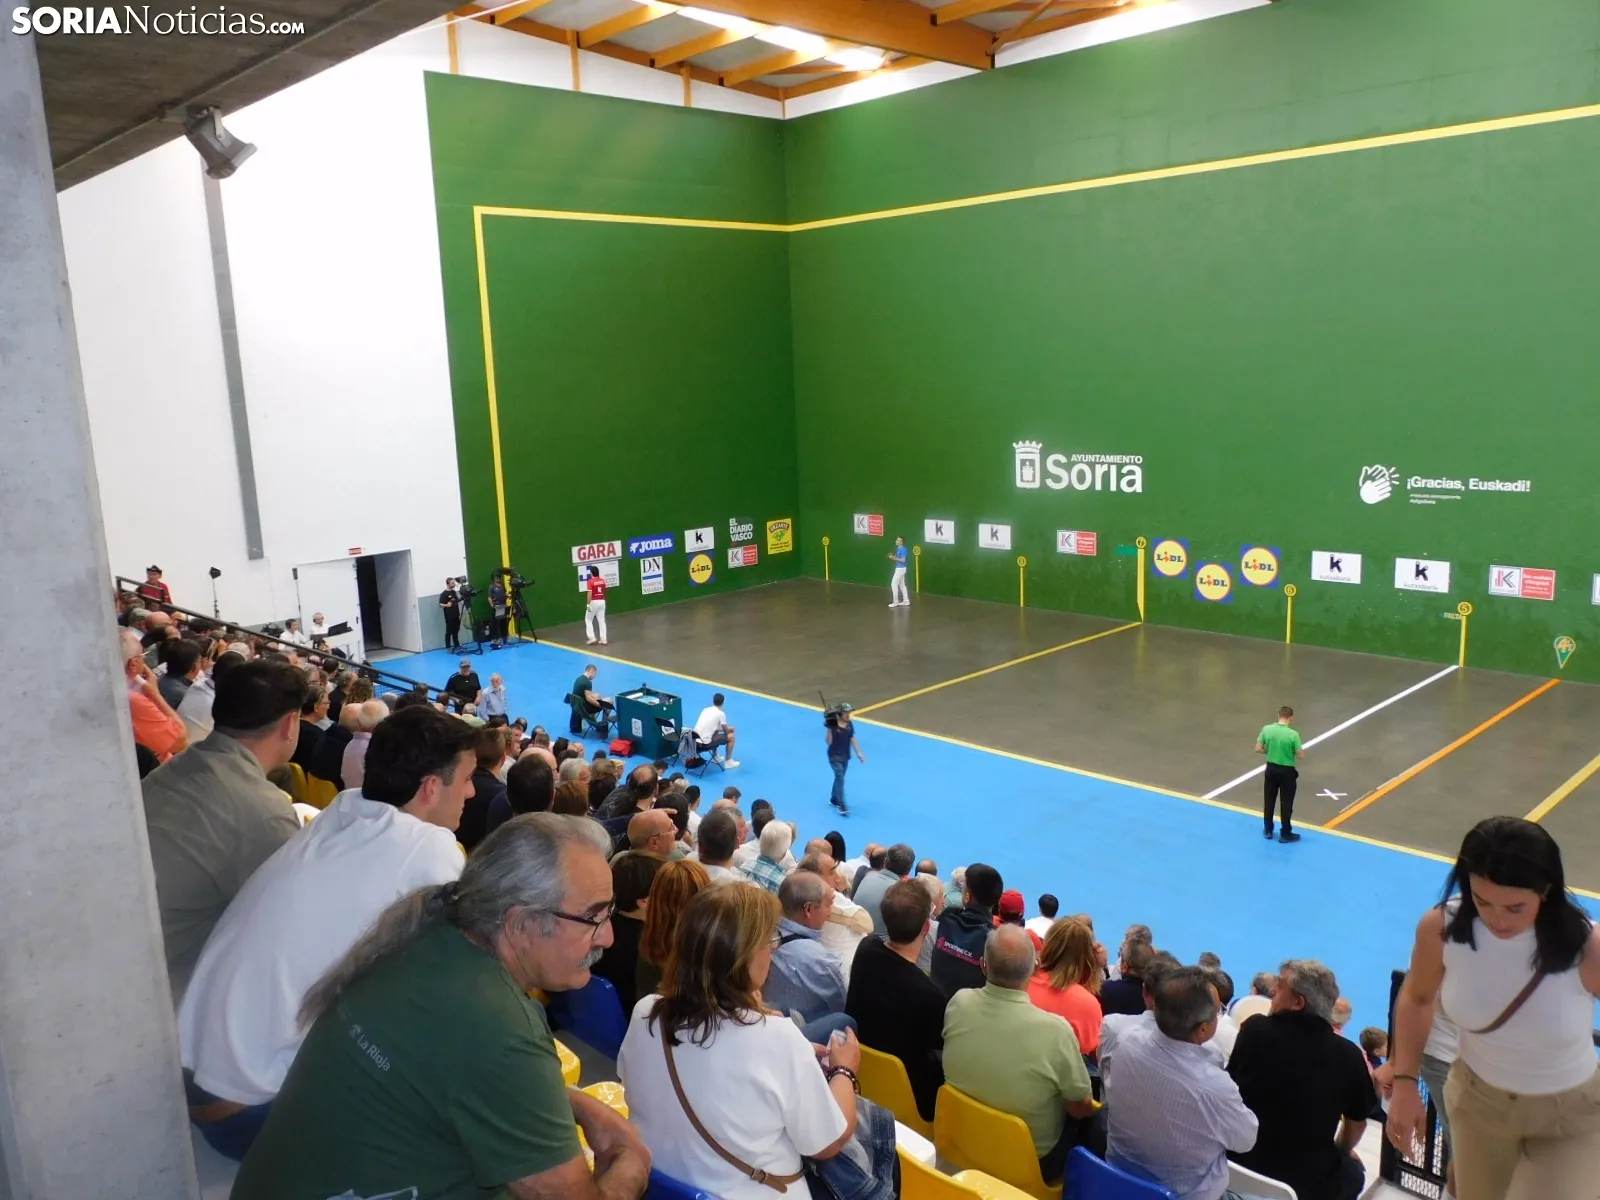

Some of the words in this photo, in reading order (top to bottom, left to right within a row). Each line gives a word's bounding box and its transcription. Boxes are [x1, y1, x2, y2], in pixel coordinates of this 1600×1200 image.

[1071, 454, 1143, 464] AYUNTAMIENTO
[1045, 453, 1143, 493] Soria
[1406, 476, 1465, 491] ¡Gracias,
[1469, 478, 1531, 492] Euskadi!
[729, 518, 738, 526] EL
[729, 523, 753, 534] DIARIO
[730, 532, 753, 542] VASCO
[577, 543, 616, 561] GARA
[642, 558, 660, 573] DN
[357, 1034, 369, 1050] La
[366, 1044, 391, 1071] Rioja
